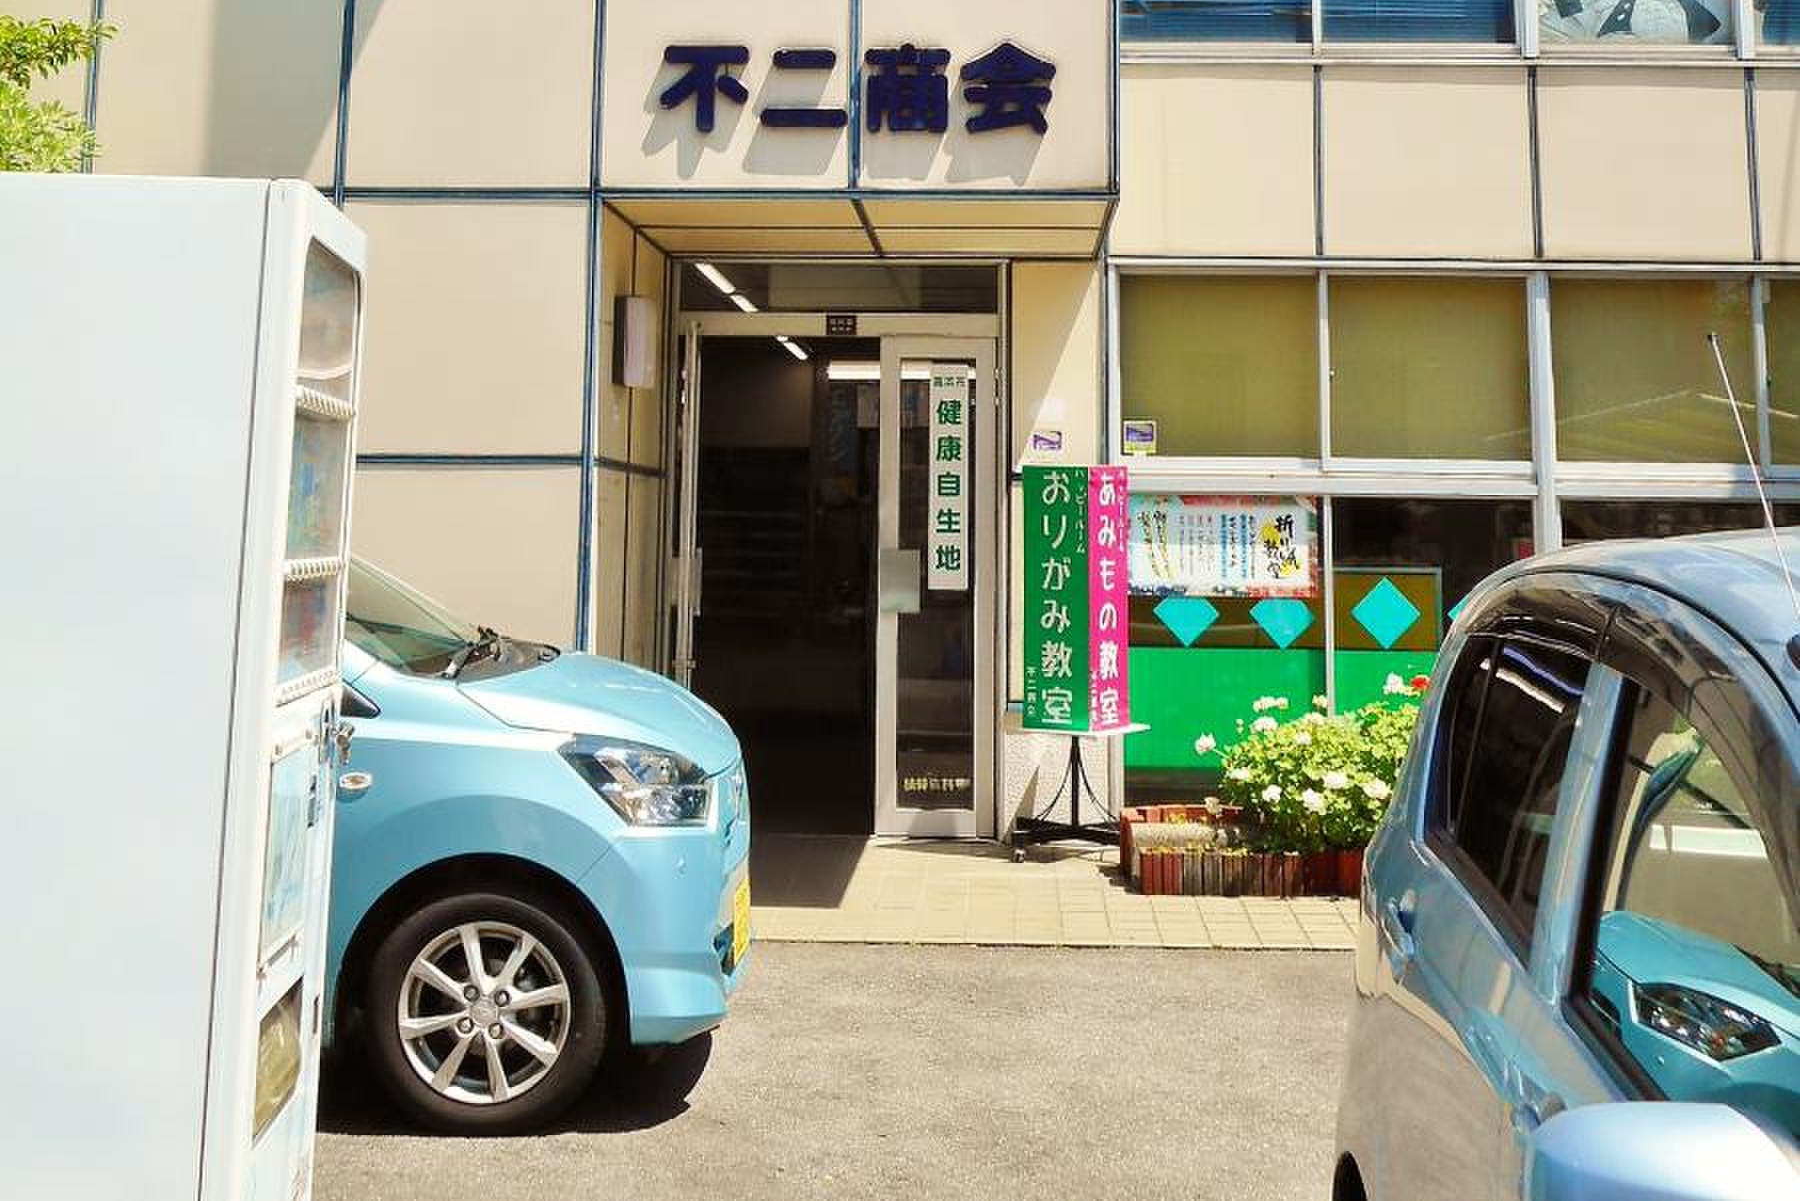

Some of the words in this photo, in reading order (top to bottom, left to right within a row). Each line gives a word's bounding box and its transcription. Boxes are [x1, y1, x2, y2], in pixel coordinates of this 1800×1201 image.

[660, 42, 1056, 133] 不二商会
[936, 400, 962, 571] 健康自生地
[1041, 470, 1073, 725] おりがみ教室
[1097, 471, 1119, 725] あみもの教室
